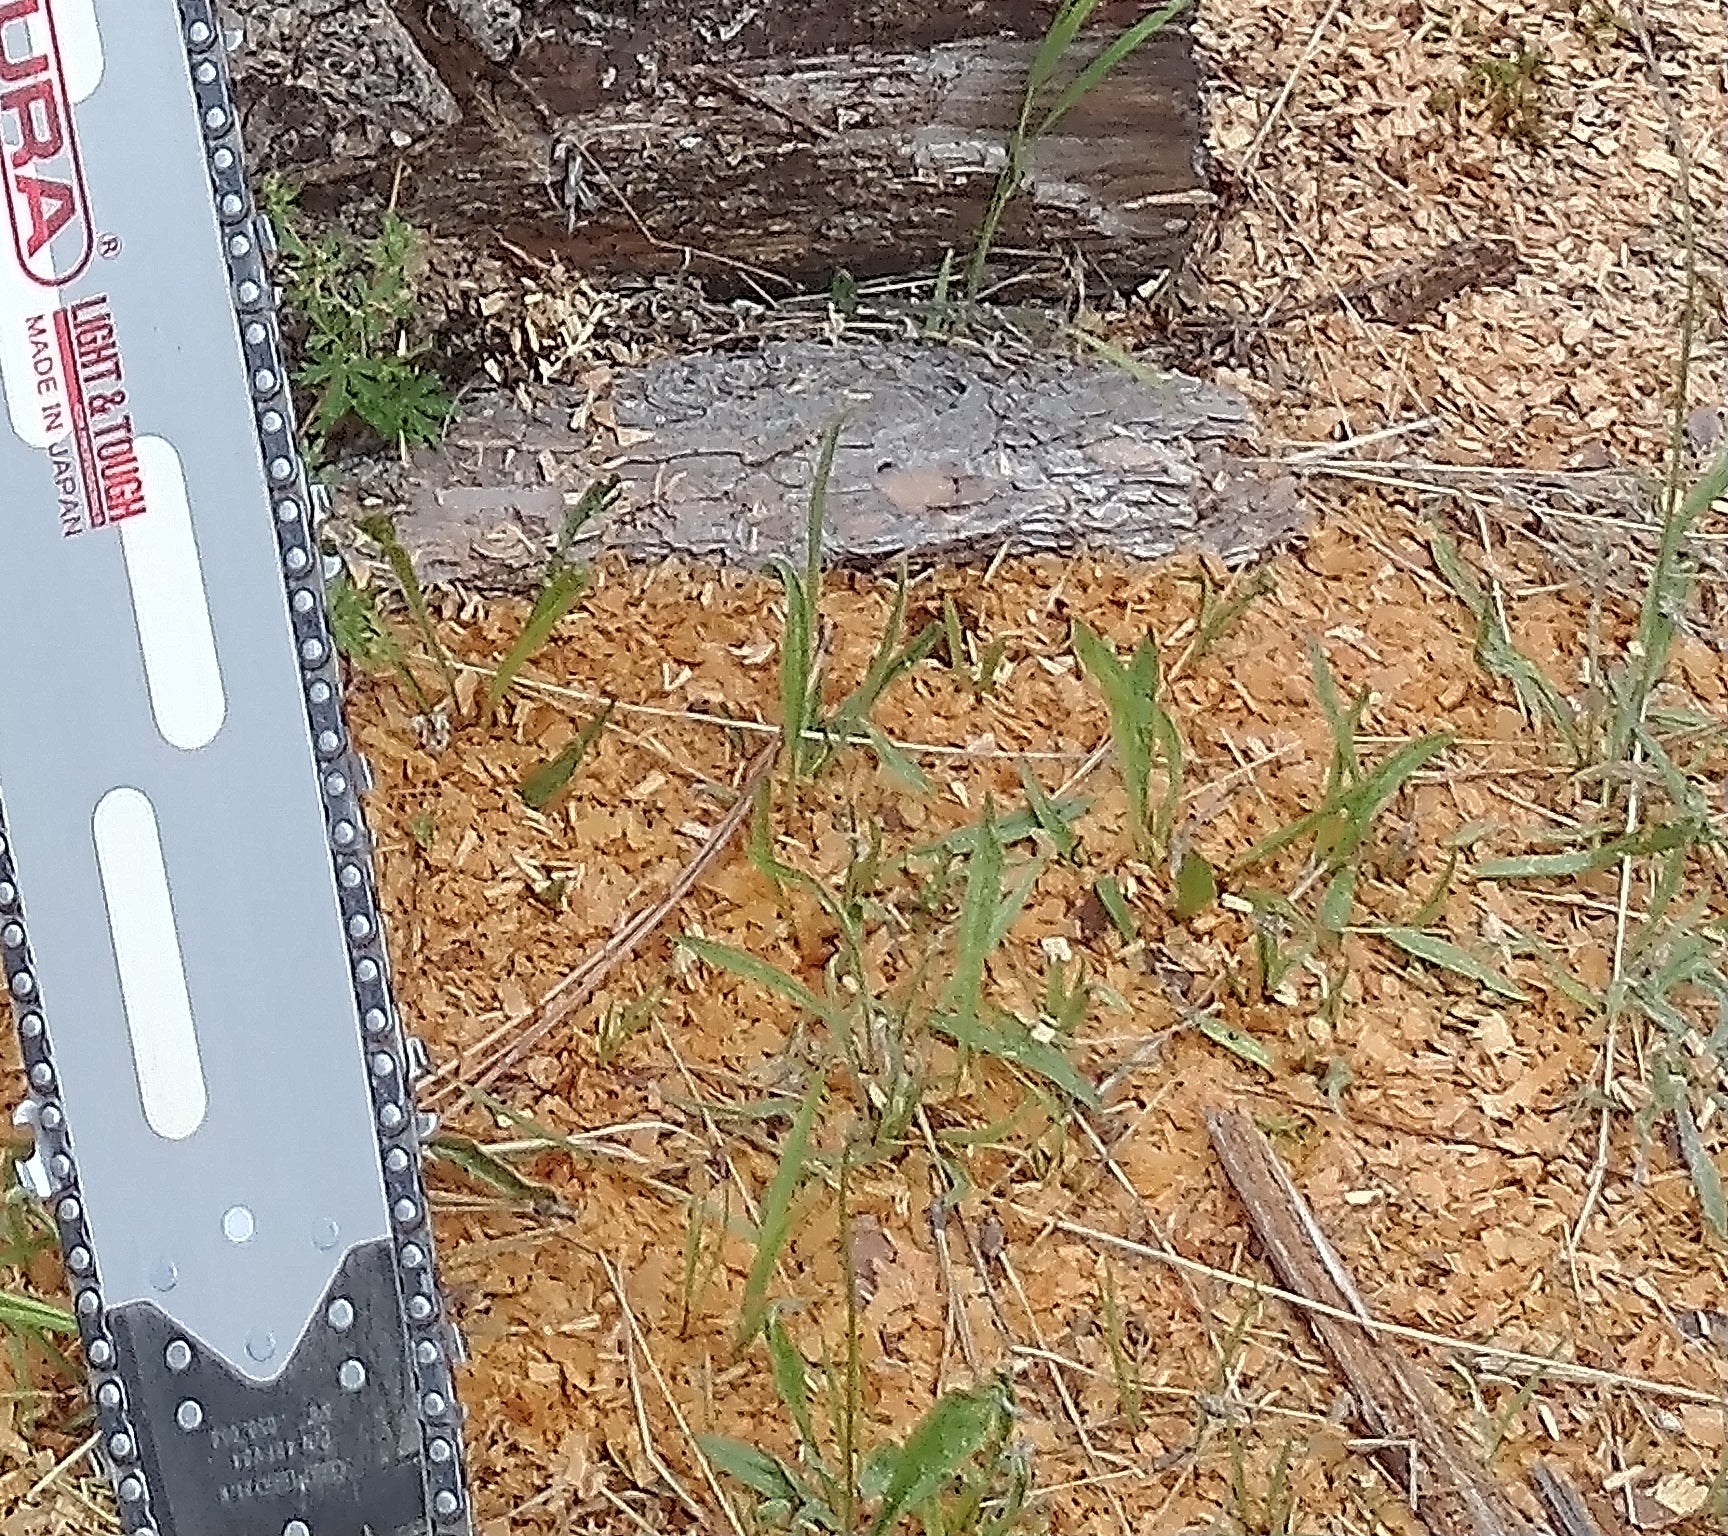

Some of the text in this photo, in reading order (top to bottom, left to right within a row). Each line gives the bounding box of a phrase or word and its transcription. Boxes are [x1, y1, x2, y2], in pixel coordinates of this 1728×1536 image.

[25, 314, 83, 539] MADE IN JAPAN
[71, 295, 147, 523] LIGHT & TOUGH
